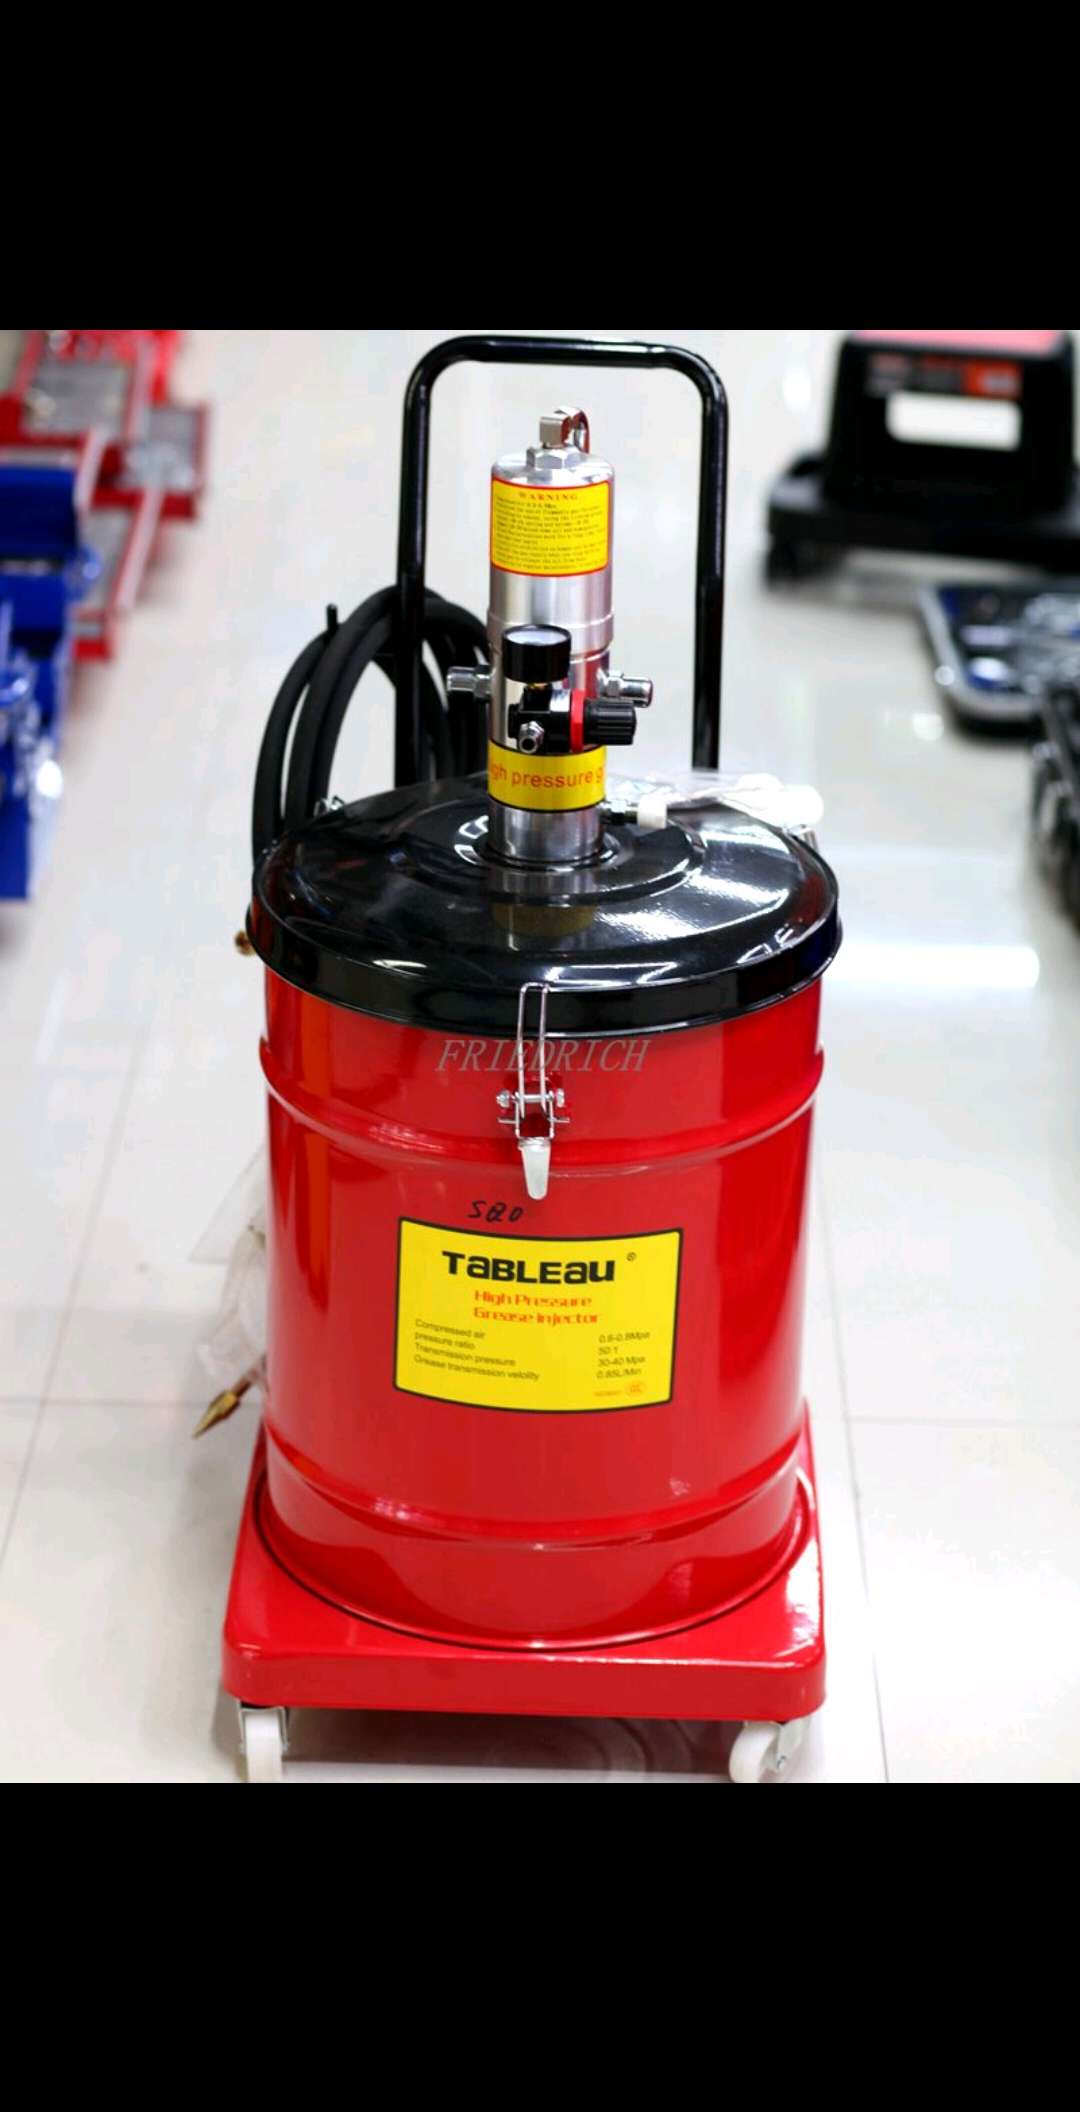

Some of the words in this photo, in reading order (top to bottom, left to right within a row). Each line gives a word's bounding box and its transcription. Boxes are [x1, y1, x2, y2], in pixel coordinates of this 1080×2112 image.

[518, 491, 578, 501] WARNING
[511, 770, 593, 787] pressure
[474, 1290, 512, 1305] High
[515, 1293, 592, 1308] Pressure
[473, 1306, 534, 1323] Grease
[415, 1318, 472, 1337] Compressed
[473, 1330, 486, 1339] air
[415, 1332, 453, 1346] pressure
[454, 1339, 476, 1350] ratio
[415, 1342, 473, 1360] Transmission
[474, 1355, 516, 1367] pressure
[413, 1354, 447, 1368] Grease
[447, 1362, 506, 1377] transmission
